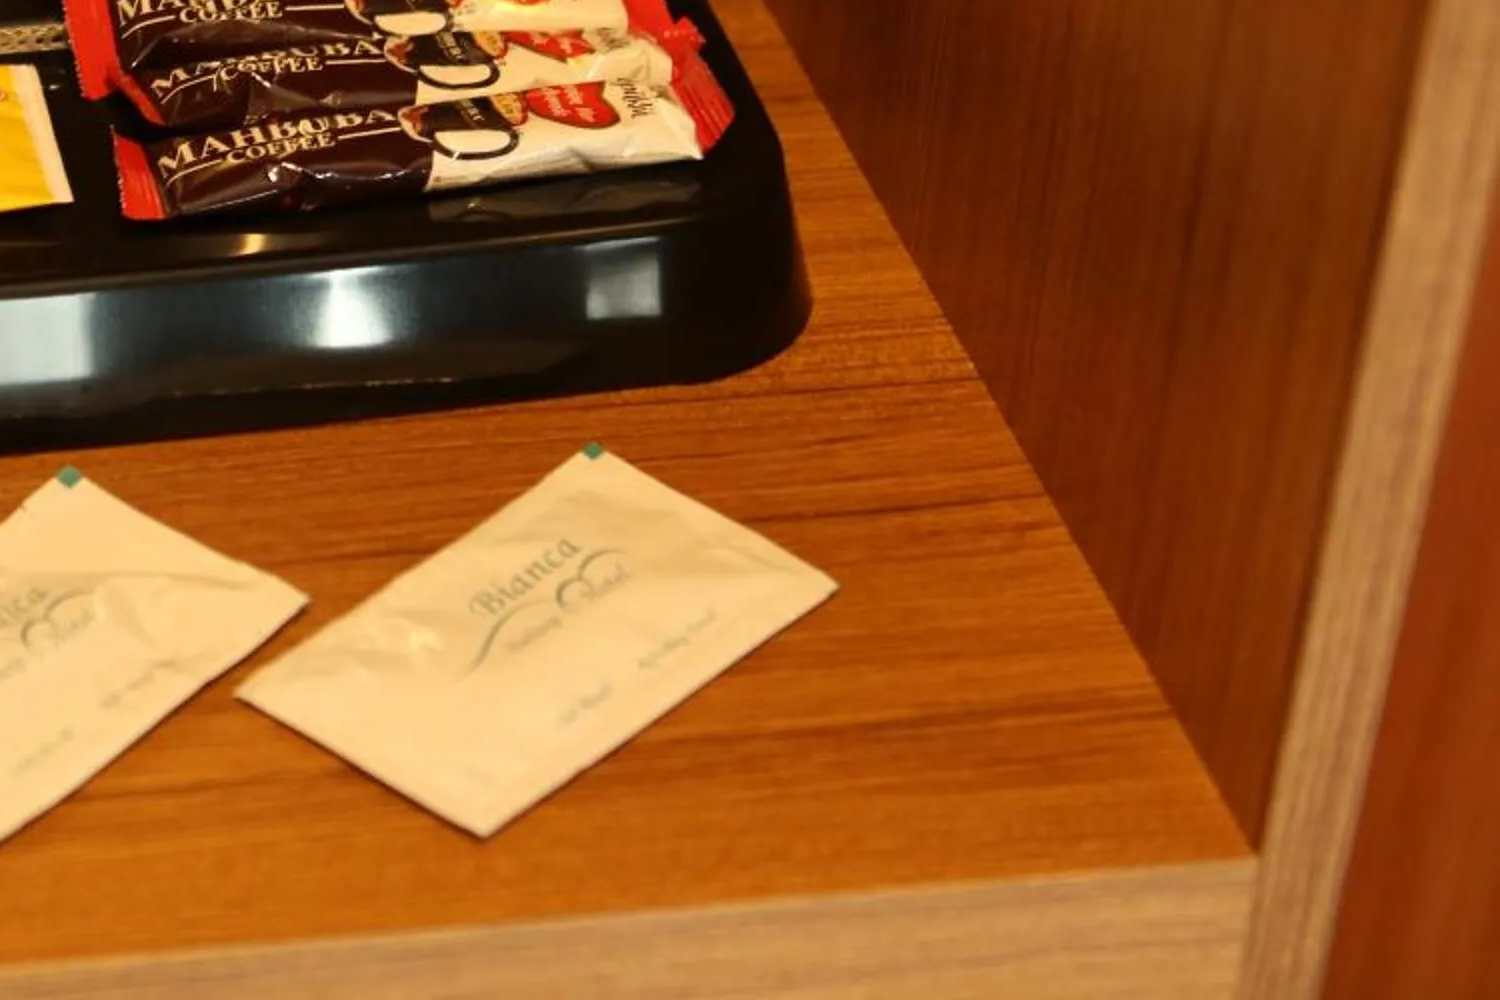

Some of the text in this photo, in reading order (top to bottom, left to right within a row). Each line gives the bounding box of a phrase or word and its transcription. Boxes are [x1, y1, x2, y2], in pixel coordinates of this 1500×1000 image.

[156, 109, 398, 180] MAHBUBA
[225, 132, 337, 164] COFFEE
[468, 536, 582, 617] Bianca
